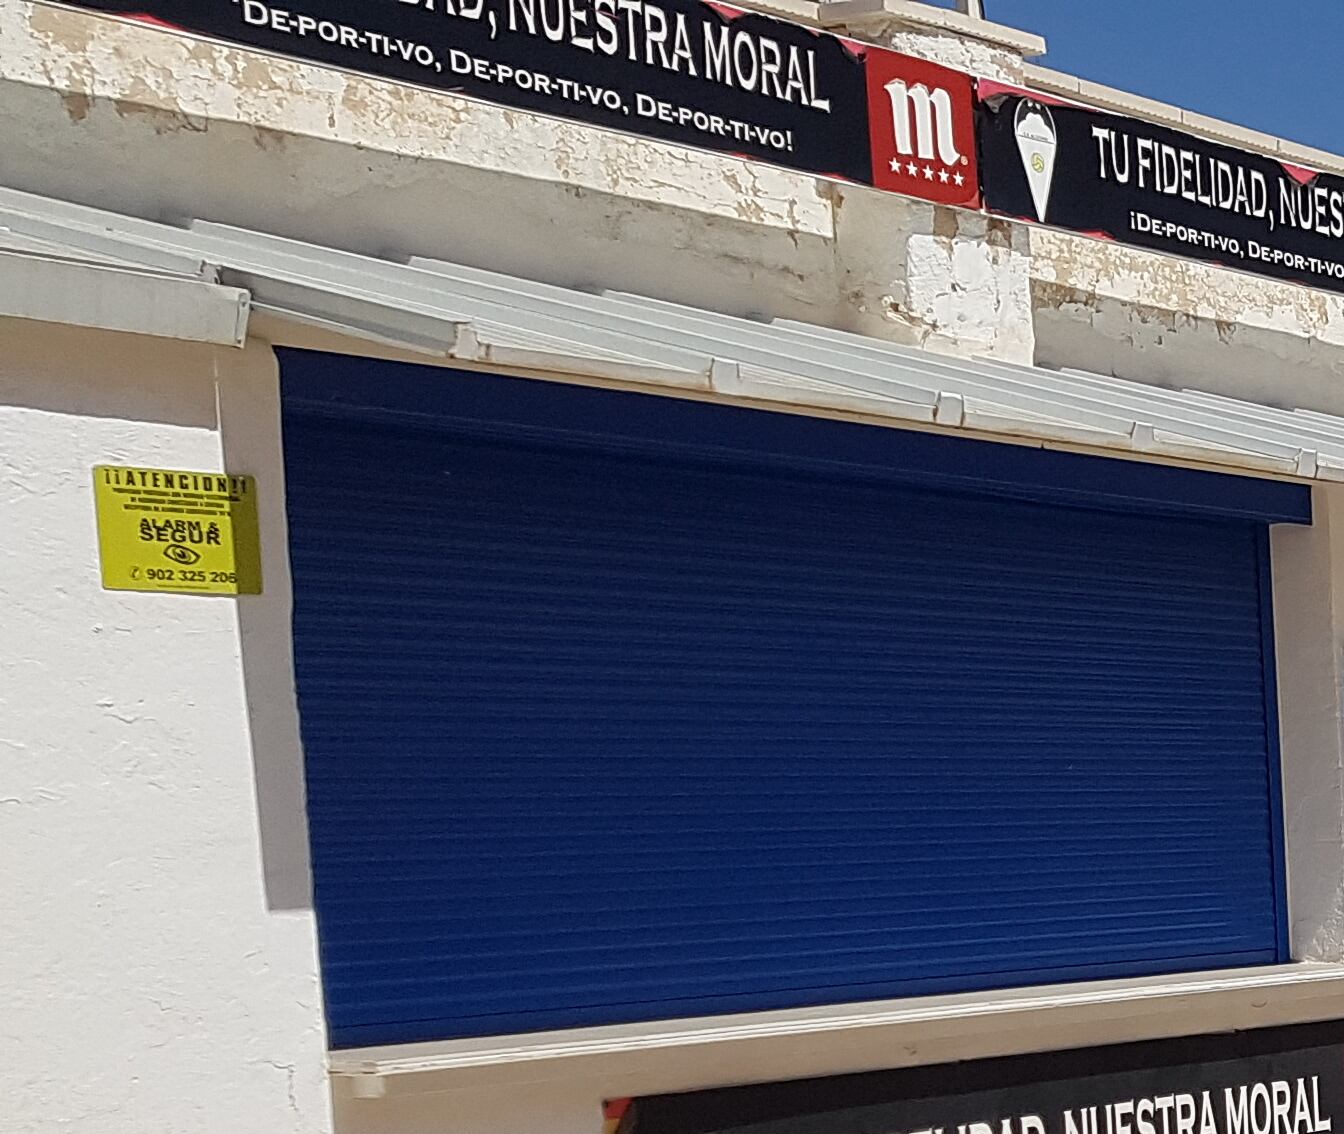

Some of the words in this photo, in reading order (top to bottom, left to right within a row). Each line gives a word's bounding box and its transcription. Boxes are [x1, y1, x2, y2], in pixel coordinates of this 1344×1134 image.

[232, 0, 441, 72] DE-POR-TI-VO,
[702, 20, 831, 113] MORAL
[1091, 125, 1130, 183] TU
[1136, 137, 1275, 232] FIDELIDAD,
[140, 528, 221, 545] SEGUR
[146, 568, 175, 581] 902
[178, 570, 206, 582] 325
